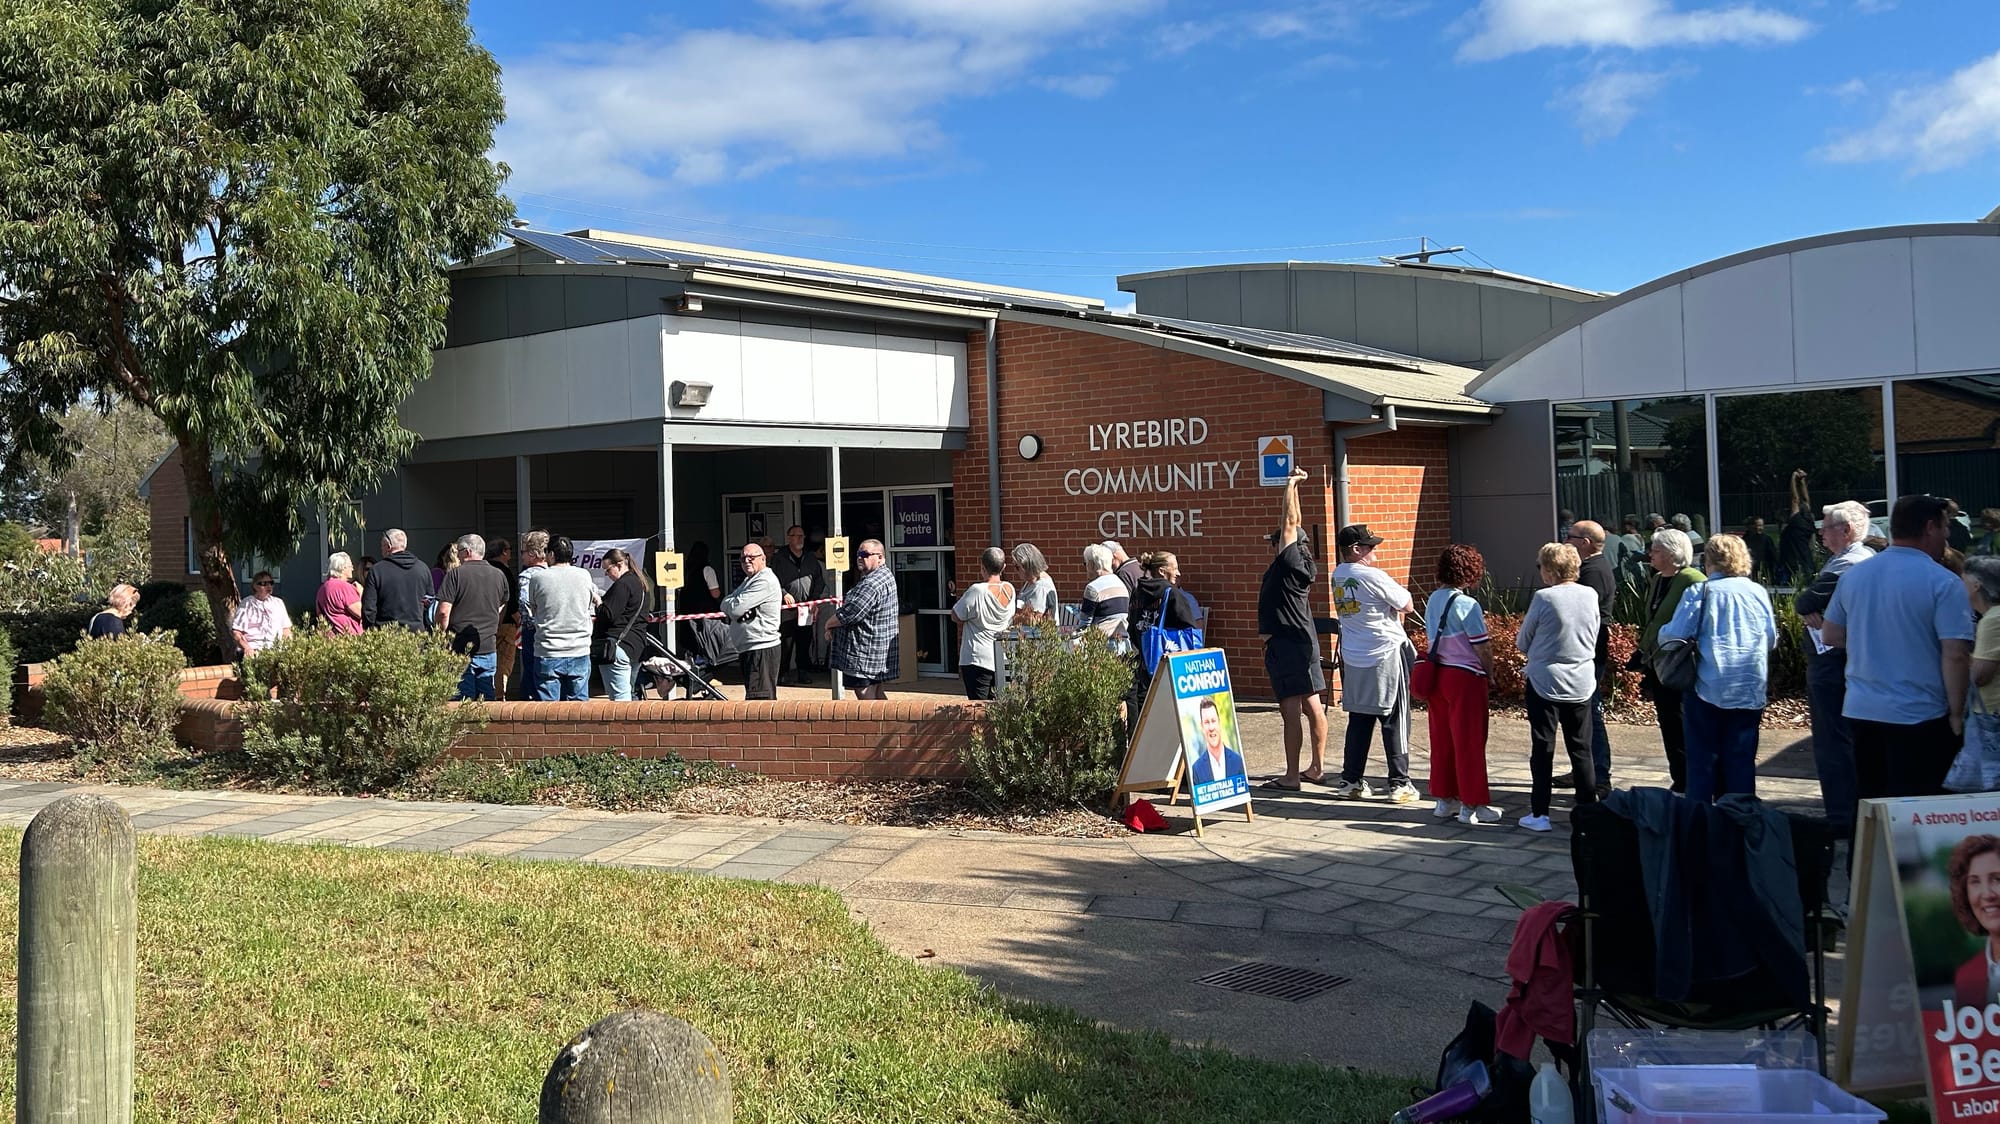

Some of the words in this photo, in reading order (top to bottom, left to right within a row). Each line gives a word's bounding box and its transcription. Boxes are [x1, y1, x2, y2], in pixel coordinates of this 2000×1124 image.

[1089, 417, 1208, 451] LYREBIRD
[1064, 461, 1241, 495] COMMUNITY
[899, 512, 930, 523] Voting
[1098, 509, 1203, 538] CENTRE
[1185, 658, 1216, 674] NATHAN
[1178, 670, 1226, 693] CONROY
[1912, 812, 1923, 825] A
[1925, 811, 1967, 826] strong
[1952, 1098, 1999, 1118] Labor
